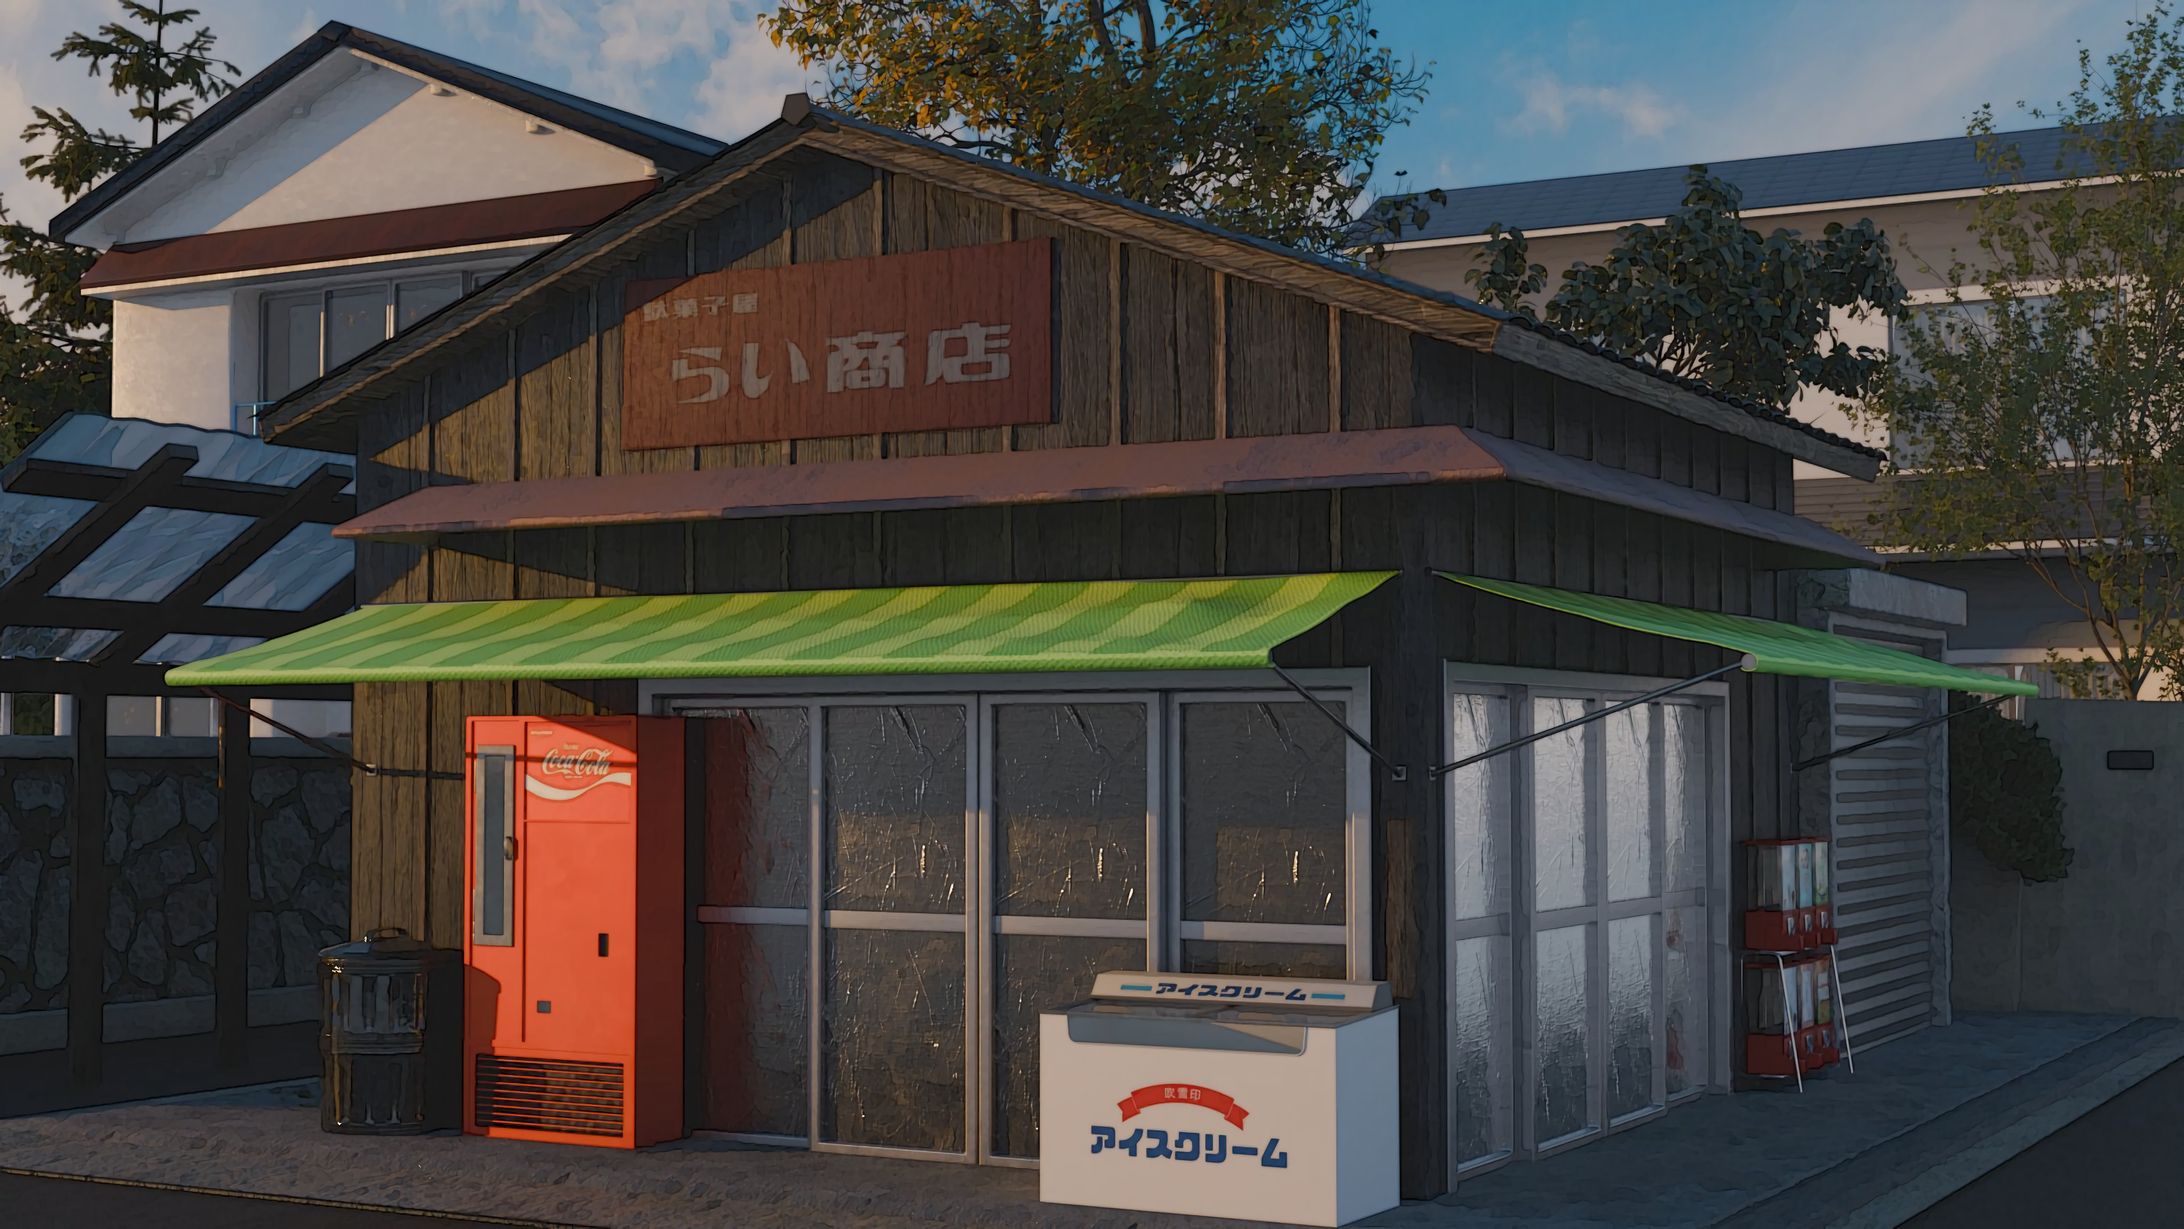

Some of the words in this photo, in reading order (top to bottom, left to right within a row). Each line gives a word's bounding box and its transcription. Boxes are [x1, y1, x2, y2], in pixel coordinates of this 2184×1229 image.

[671, 321, 1012, 404] らい商店
[542, 748, 614, 775] Coca-Cola
[1156, 982, 1307, 1001] アイスクリーム
[1091, 1125, 1288, 1168] アイスクリーム
